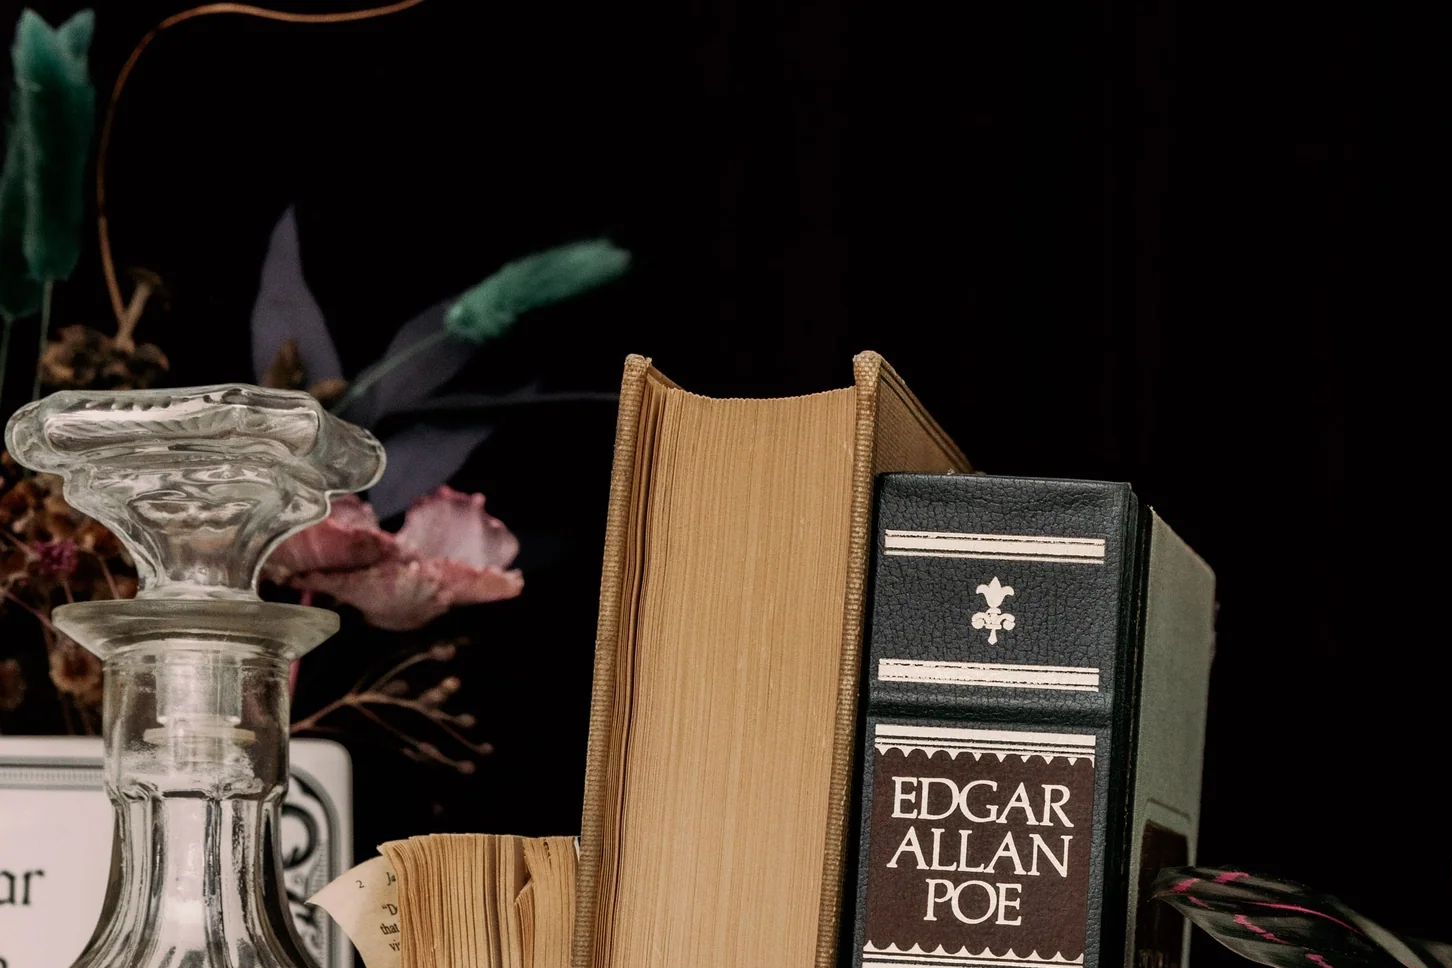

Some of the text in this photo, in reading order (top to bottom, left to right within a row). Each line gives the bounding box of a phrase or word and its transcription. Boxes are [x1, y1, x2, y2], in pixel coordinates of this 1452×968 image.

[891, 776, 1074, 828] EDGAR
[886, 825, 1073, 878] ALLAN
[923, 877, 1022, 926] POE
